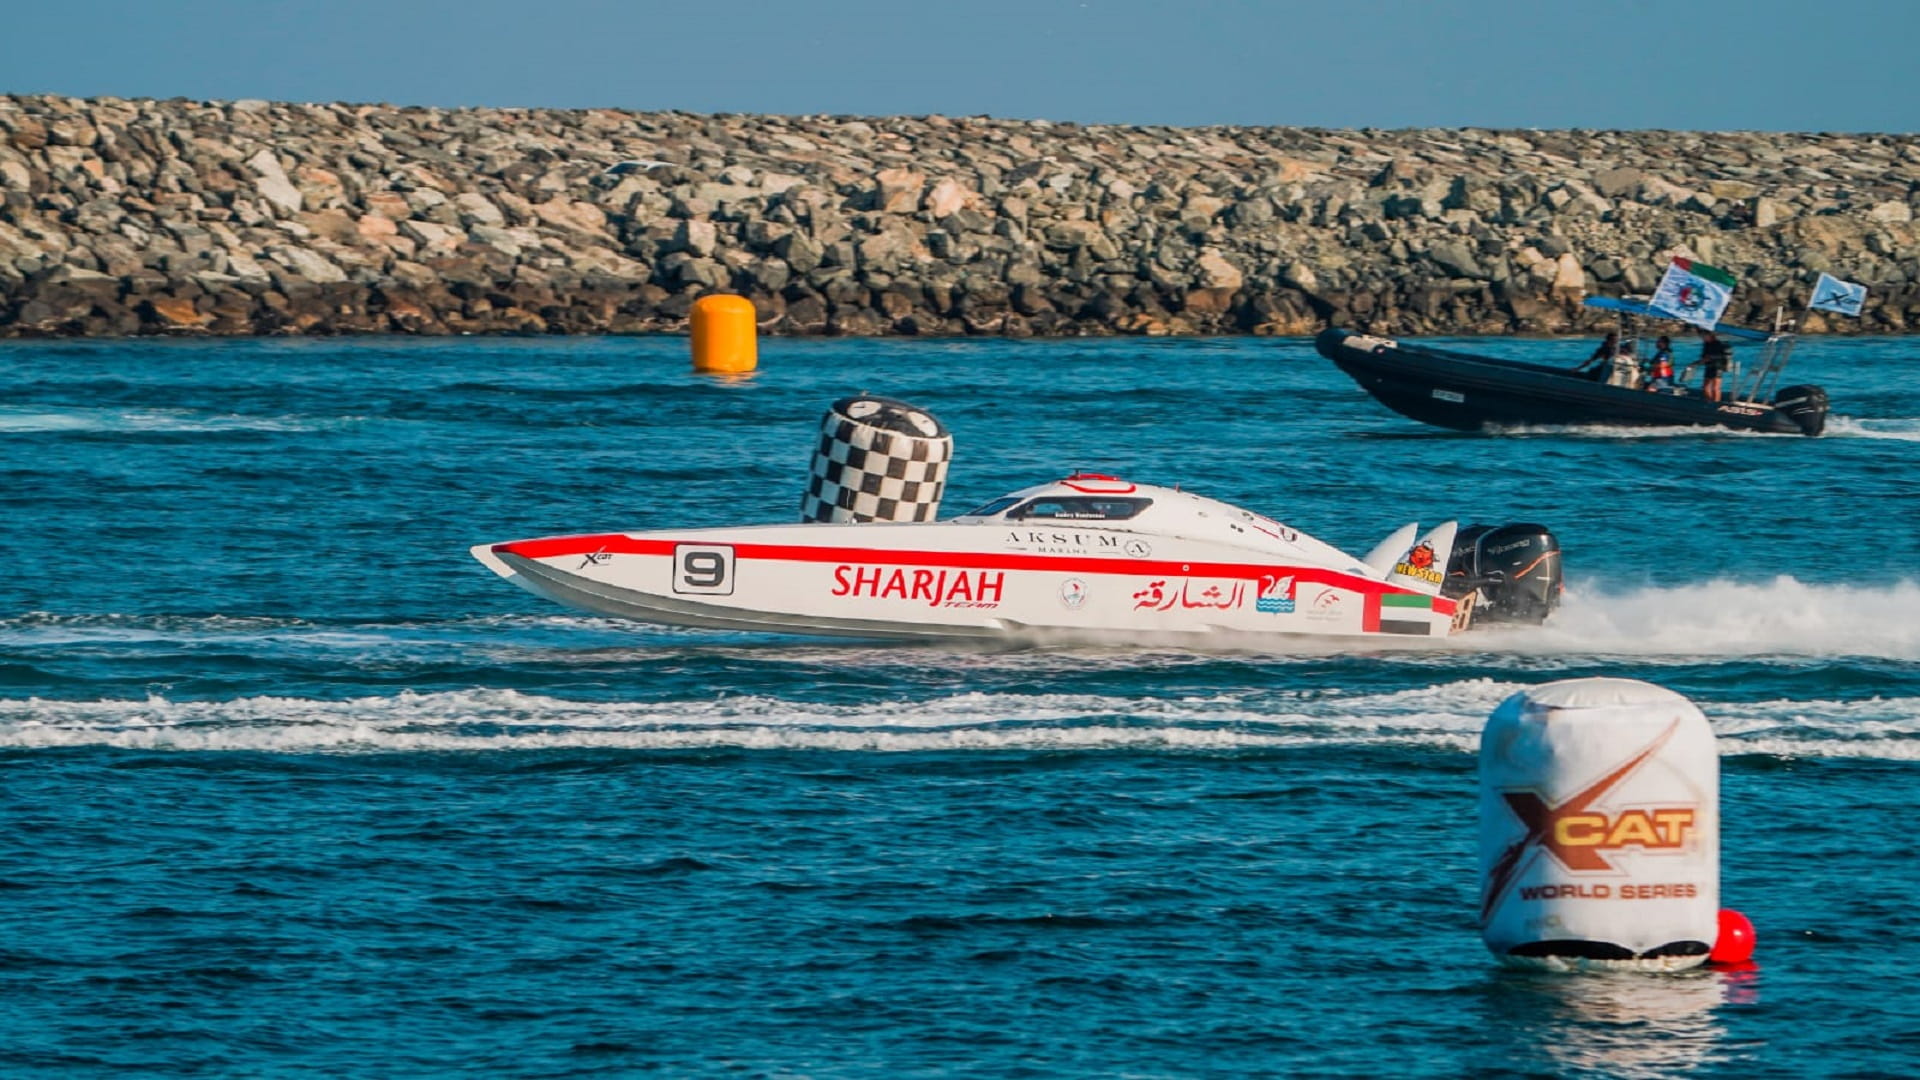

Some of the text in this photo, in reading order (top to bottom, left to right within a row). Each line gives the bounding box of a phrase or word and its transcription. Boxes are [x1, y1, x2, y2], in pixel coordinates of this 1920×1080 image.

[1006, 530, 1118, 548] AKSUM
[684, 551, 725, 587] 9
[831, 564, 1005, 607] SHARJAH
[1132, 577, 1246, 612] الشارقة
[1481, 716, 1695, 922] XCAT
[1519, 883, 1697, 901] WORLD SERIES
